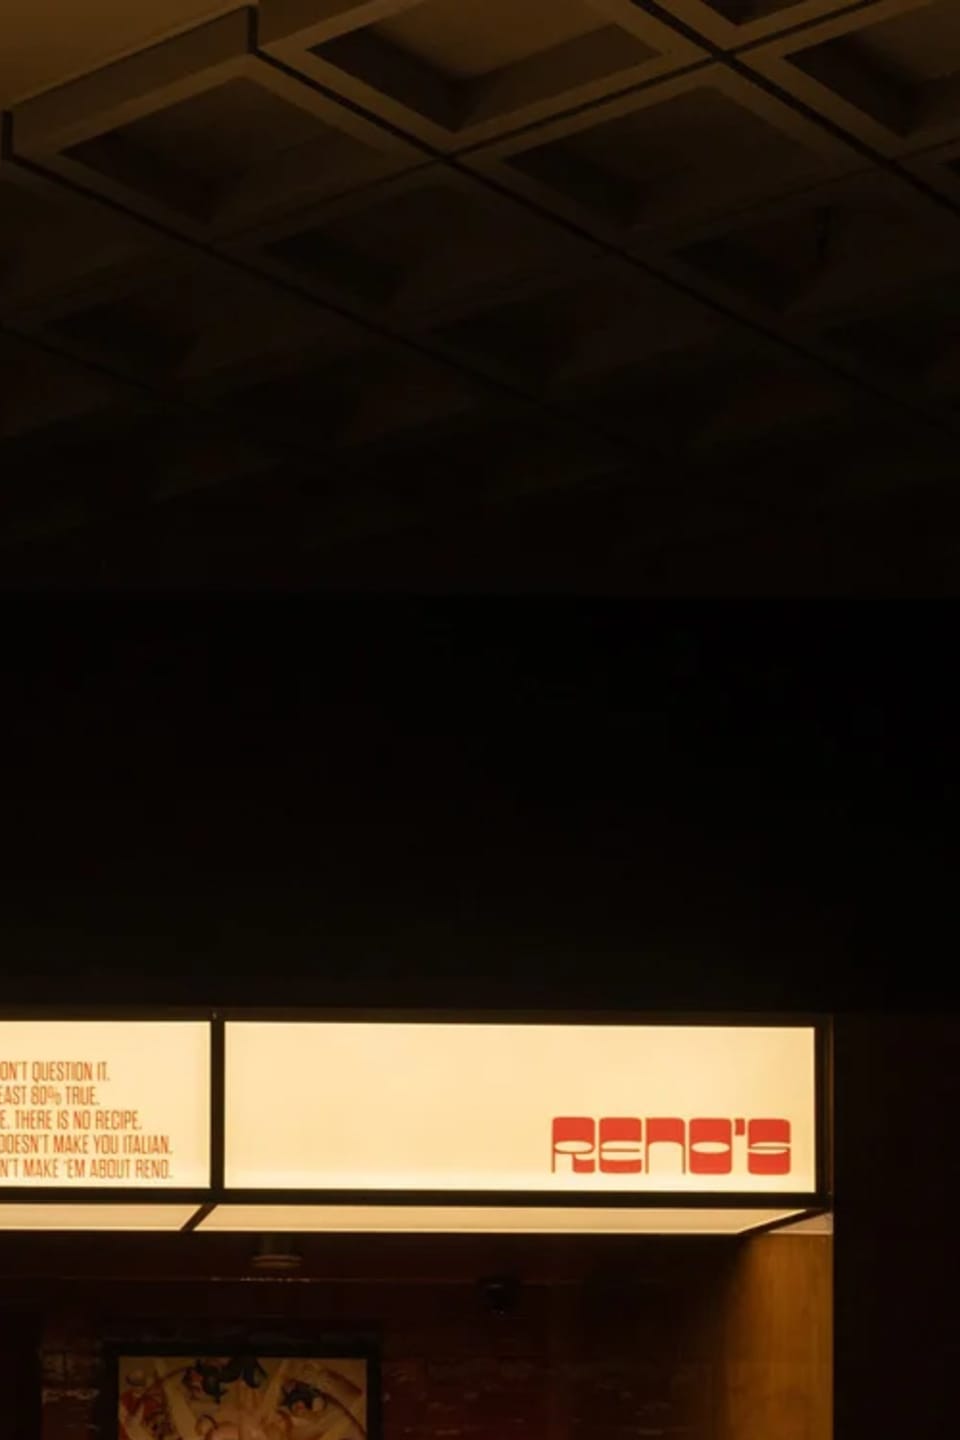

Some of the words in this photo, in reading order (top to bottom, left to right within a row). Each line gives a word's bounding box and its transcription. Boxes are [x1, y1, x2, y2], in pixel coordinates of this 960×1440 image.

[32, 1061, 93, 1083] QUESTION
[97, 1061, 110, 1081] IT.
[31, 1086, 61, 1105] 80%
[65, 1086, 99, 1105] TRUE.
[15, 1110, 52, 1130] THERE
[57, 1110, 69, 1130] IS
[73, 1110, 91, 1130] NO
[95, 1110, 142, 1130] RECIPE.
[53, 1134, 89, 1154] MAKE
[93, 1134, 118, 1154] YOU
[123, 1134, 172, 1154] ITALIAN.
[23, 1159, 59, 1179] MAKE
[90, 1159, 131, 1179] ABOUT
[135, 1159, 173, 1179] RENO.
